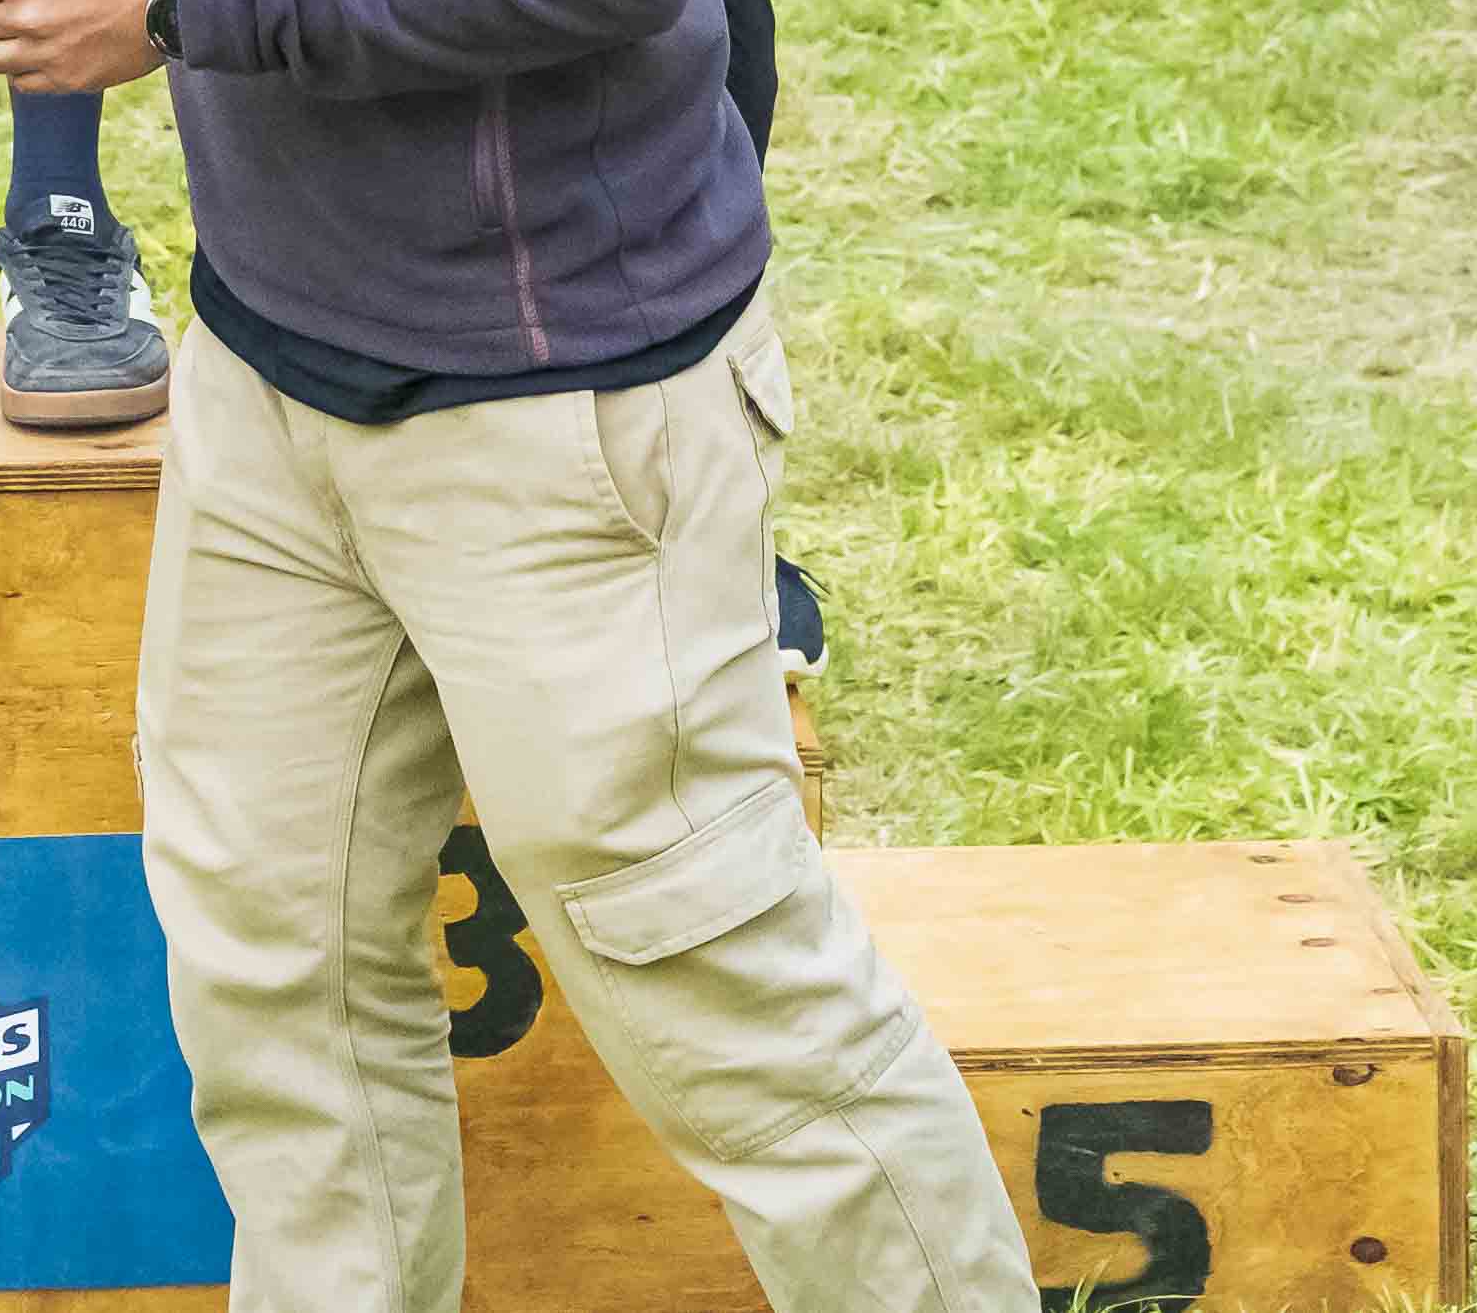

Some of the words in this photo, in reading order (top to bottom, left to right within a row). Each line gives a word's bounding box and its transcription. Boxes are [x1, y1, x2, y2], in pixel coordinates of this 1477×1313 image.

[60, 215, 87, 230] 440
[436, 826, 544, 1058] 3
[1036, 1098, 1214, 1313] 5
